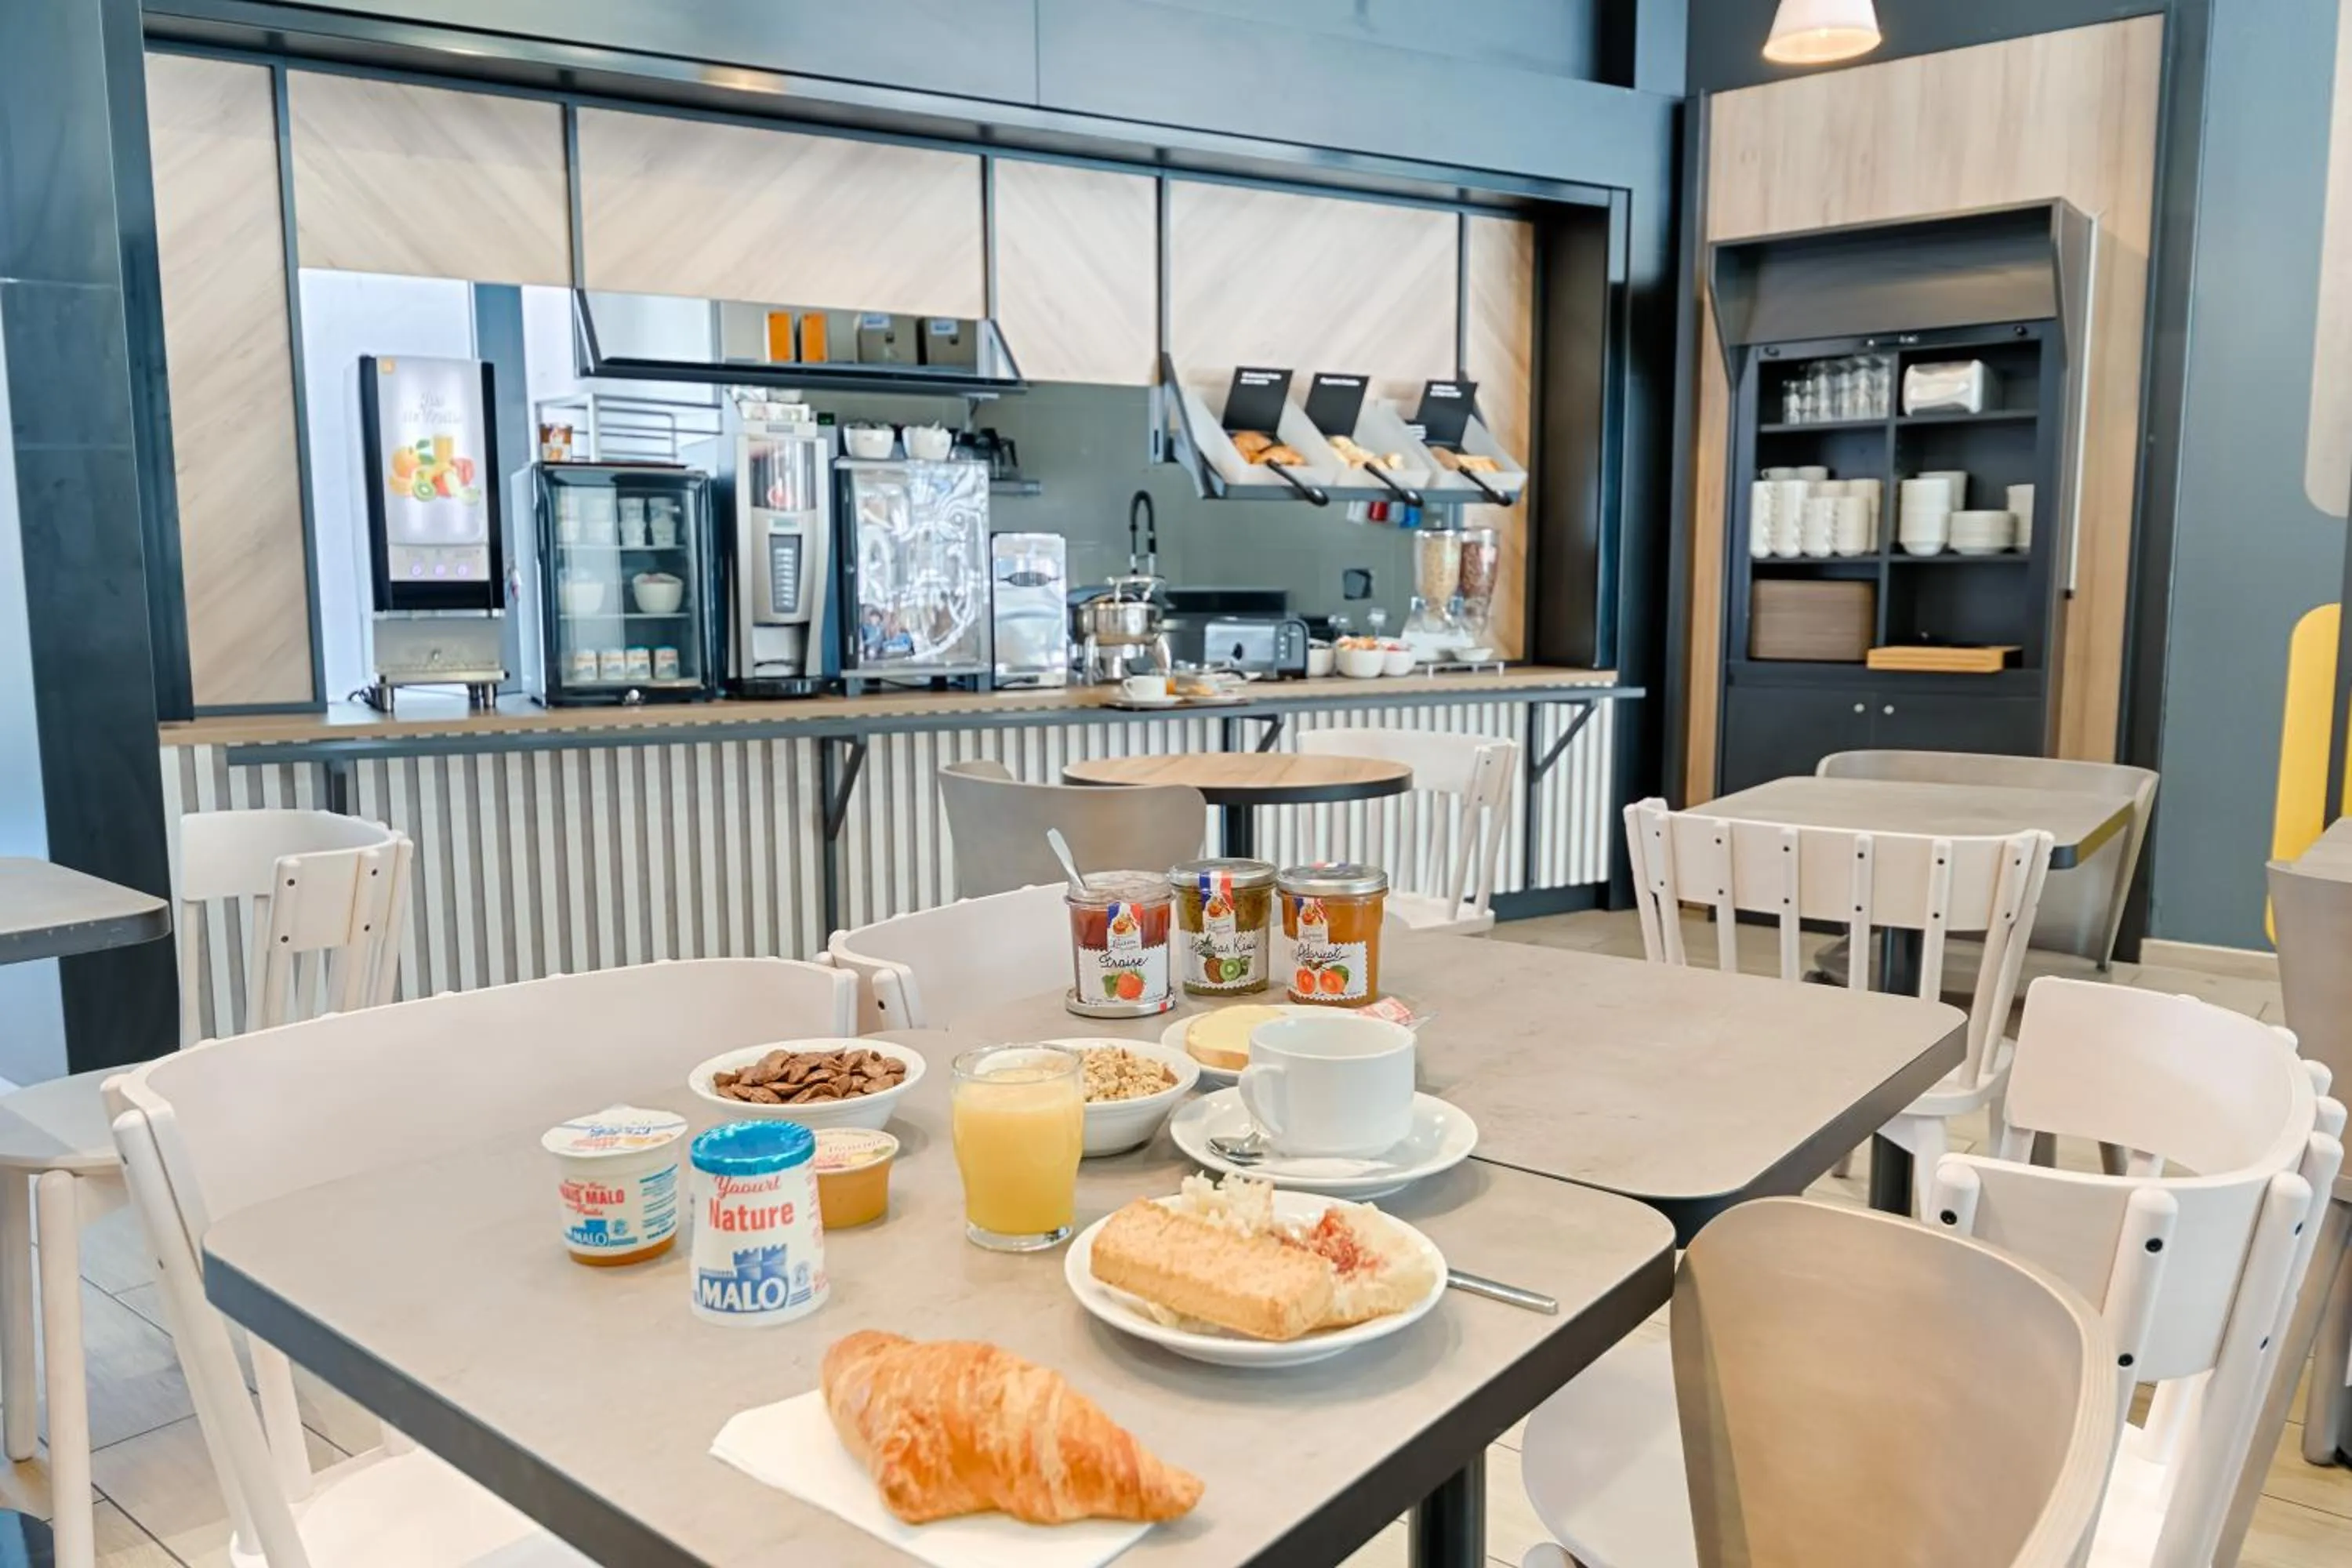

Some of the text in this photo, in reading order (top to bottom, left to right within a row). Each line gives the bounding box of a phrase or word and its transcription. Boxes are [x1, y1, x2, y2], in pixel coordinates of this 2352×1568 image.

[1098, 949, 1148, 967] Fraise
[586, 1189, 625, 1204] MALO
[710, 1177, 782, 1199] Yaourt
[709, 1199, 794, 1232] Nature
[700, 1276, 787, 1311] MALO
